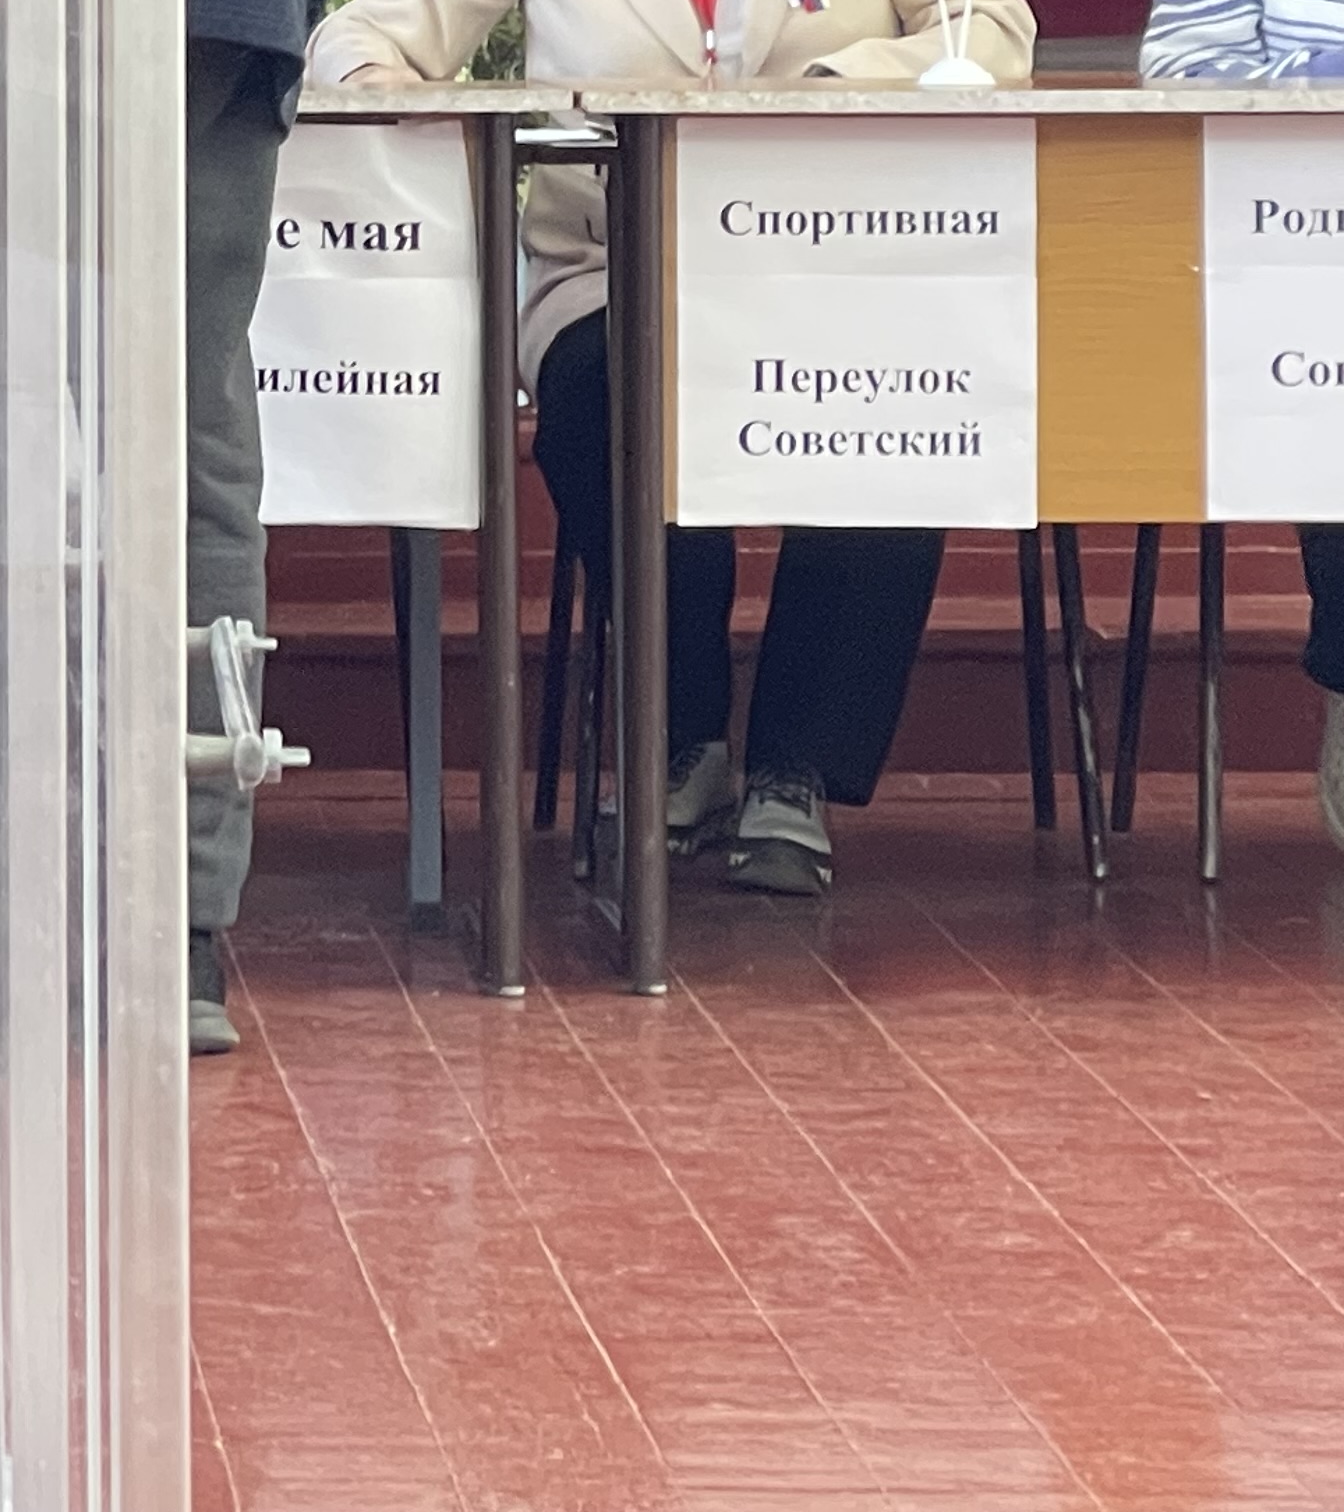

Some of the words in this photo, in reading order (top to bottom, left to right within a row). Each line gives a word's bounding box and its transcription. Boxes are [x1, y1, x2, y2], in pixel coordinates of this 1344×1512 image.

[320, 220, 422, 252] мая
[719, 200, 1000, 246] Спортивная
[257, 360, 441, 396] илейная
[752, 358, 972, 404] Переулок
[738, 419, 981, 456] Советский
